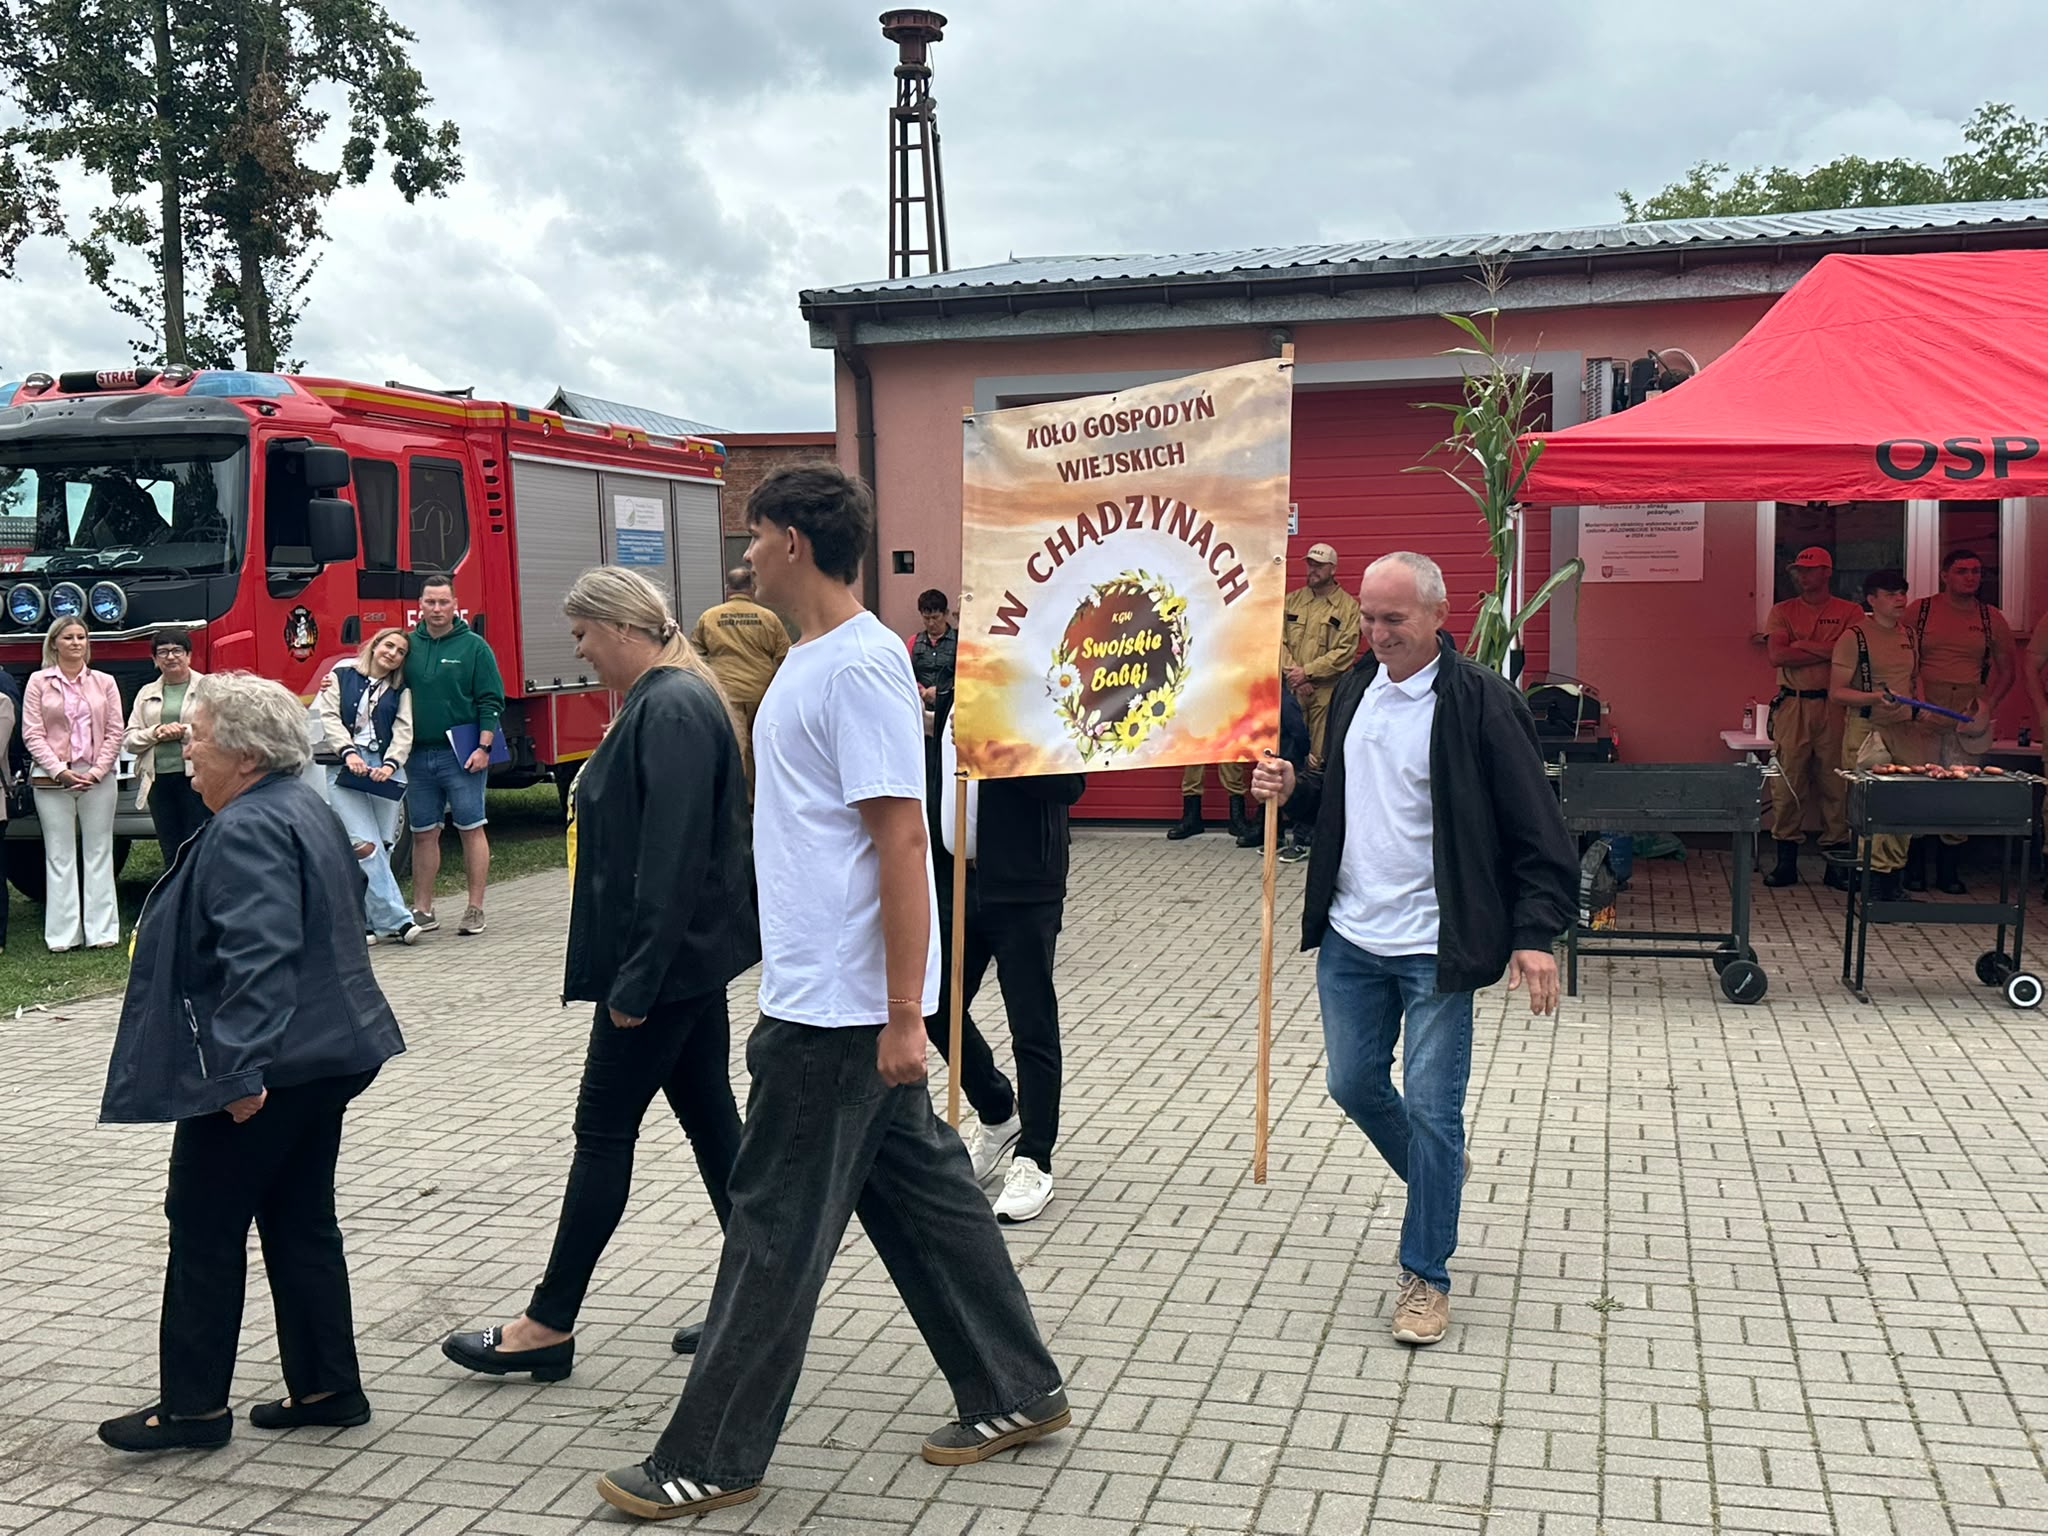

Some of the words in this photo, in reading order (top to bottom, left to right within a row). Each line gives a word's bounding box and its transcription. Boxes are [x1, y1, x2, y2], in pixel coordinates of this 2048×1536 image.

[1026, 419, 1077, 450] KOŁO
[1083, 390, 1215, 438] GOSPODYŃ
[1056, 442, 1186, 483] WIEJSKICH
[1876, 436, 2040, 481] OSP
[988, 590, 1029, 637] W
[1026, 494, 1251, 606] CHĄDZYNACH
[1111, 610, 1133, 625] KGW
[1081, 628, 1162, 659] Swojskie
[1091, 662, 1148, 691] Babki
